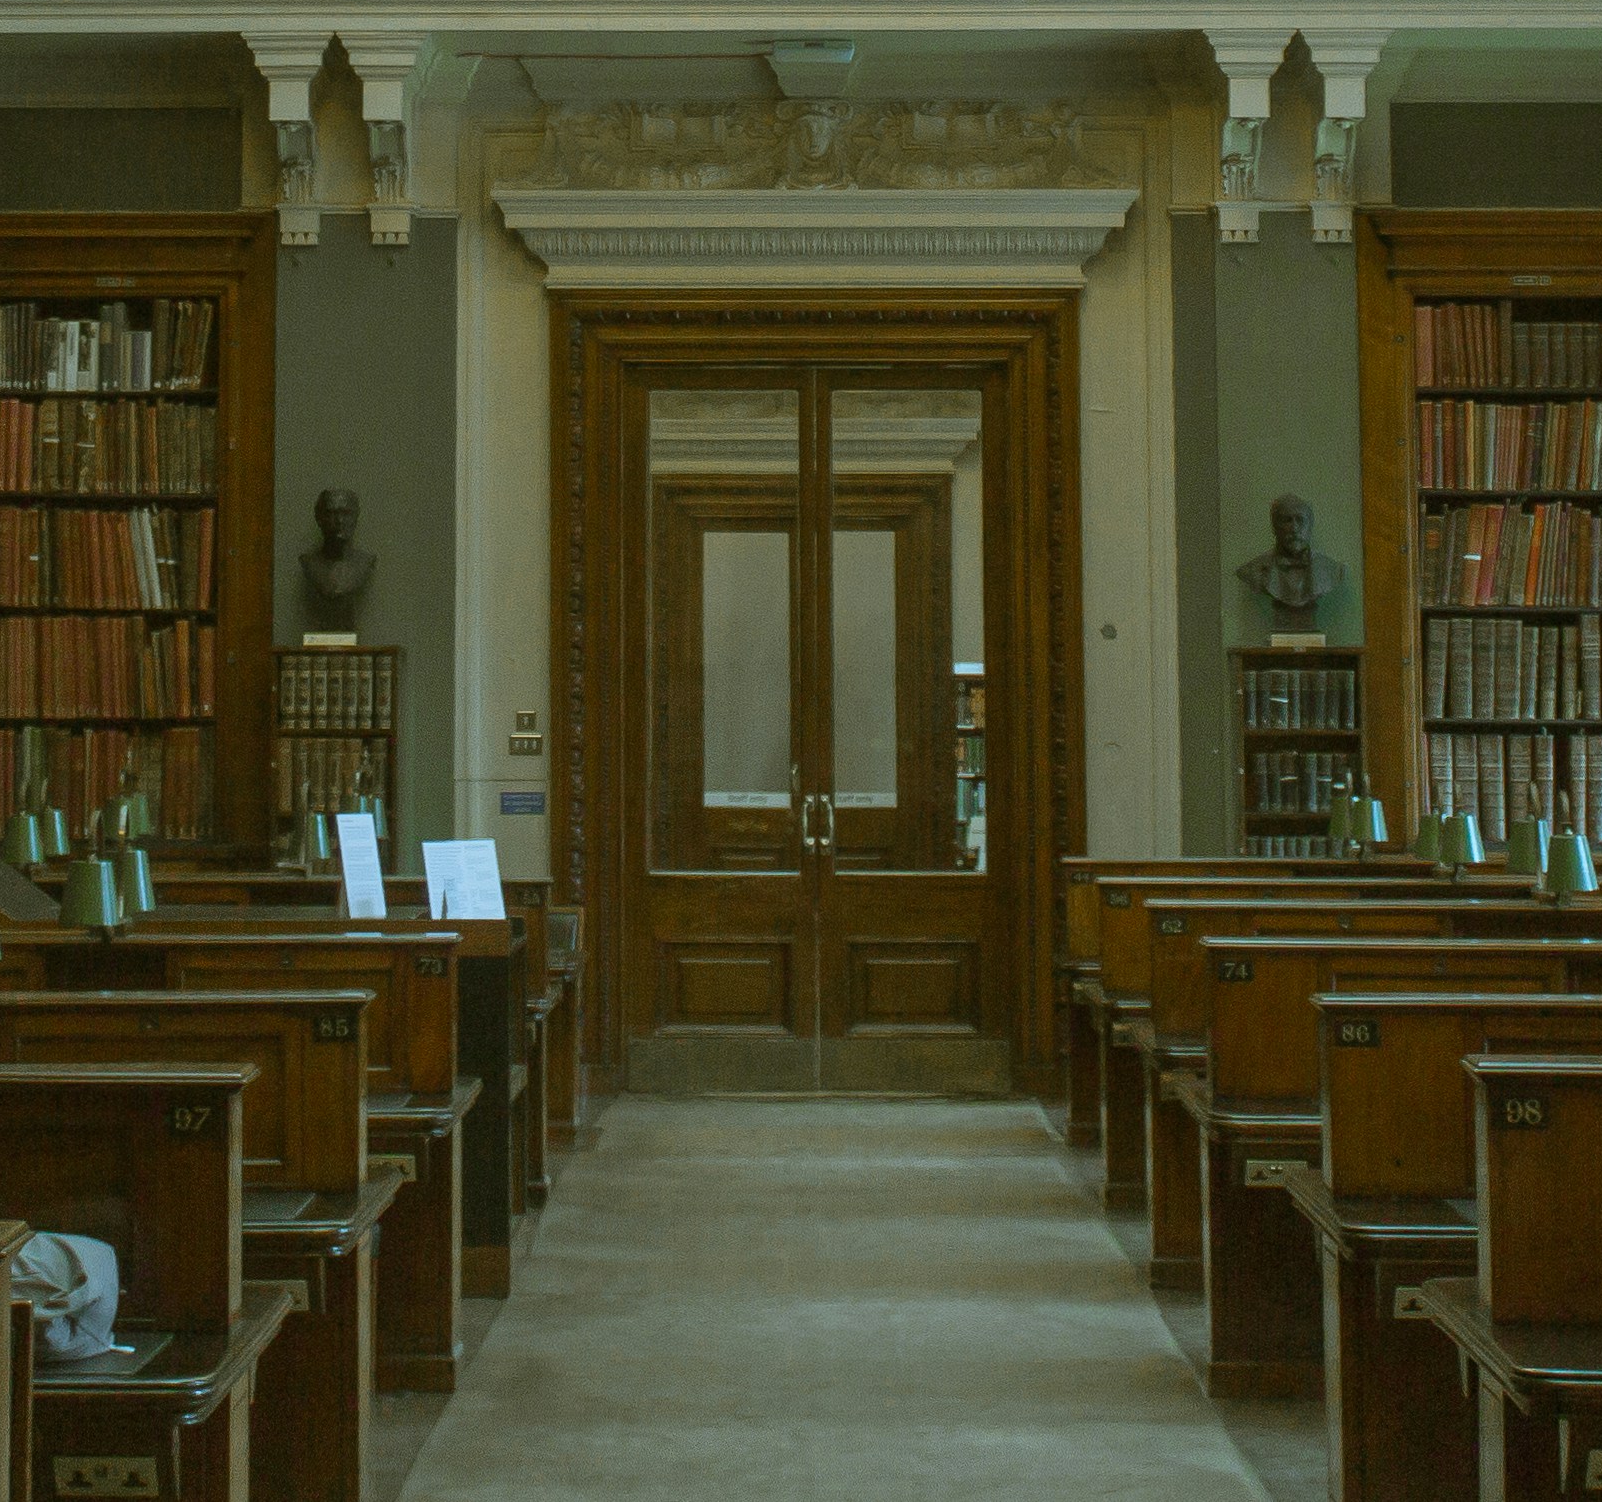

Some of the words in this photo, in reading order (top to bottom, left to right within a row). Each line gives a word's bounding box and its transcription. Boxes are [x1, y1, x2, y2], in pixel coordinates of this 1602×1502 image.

[1161, 919, 1183, 934] 62
[418, 957, 443, 975] 73
[1224, 961, 1249, 979] 74
[319, 1018, 349, 1037] 85
[1341, 1023, 1370, 1043] 86
[174, 1106, 212, 1131] 97
[1505, 1098, 1543, 1125] 98
